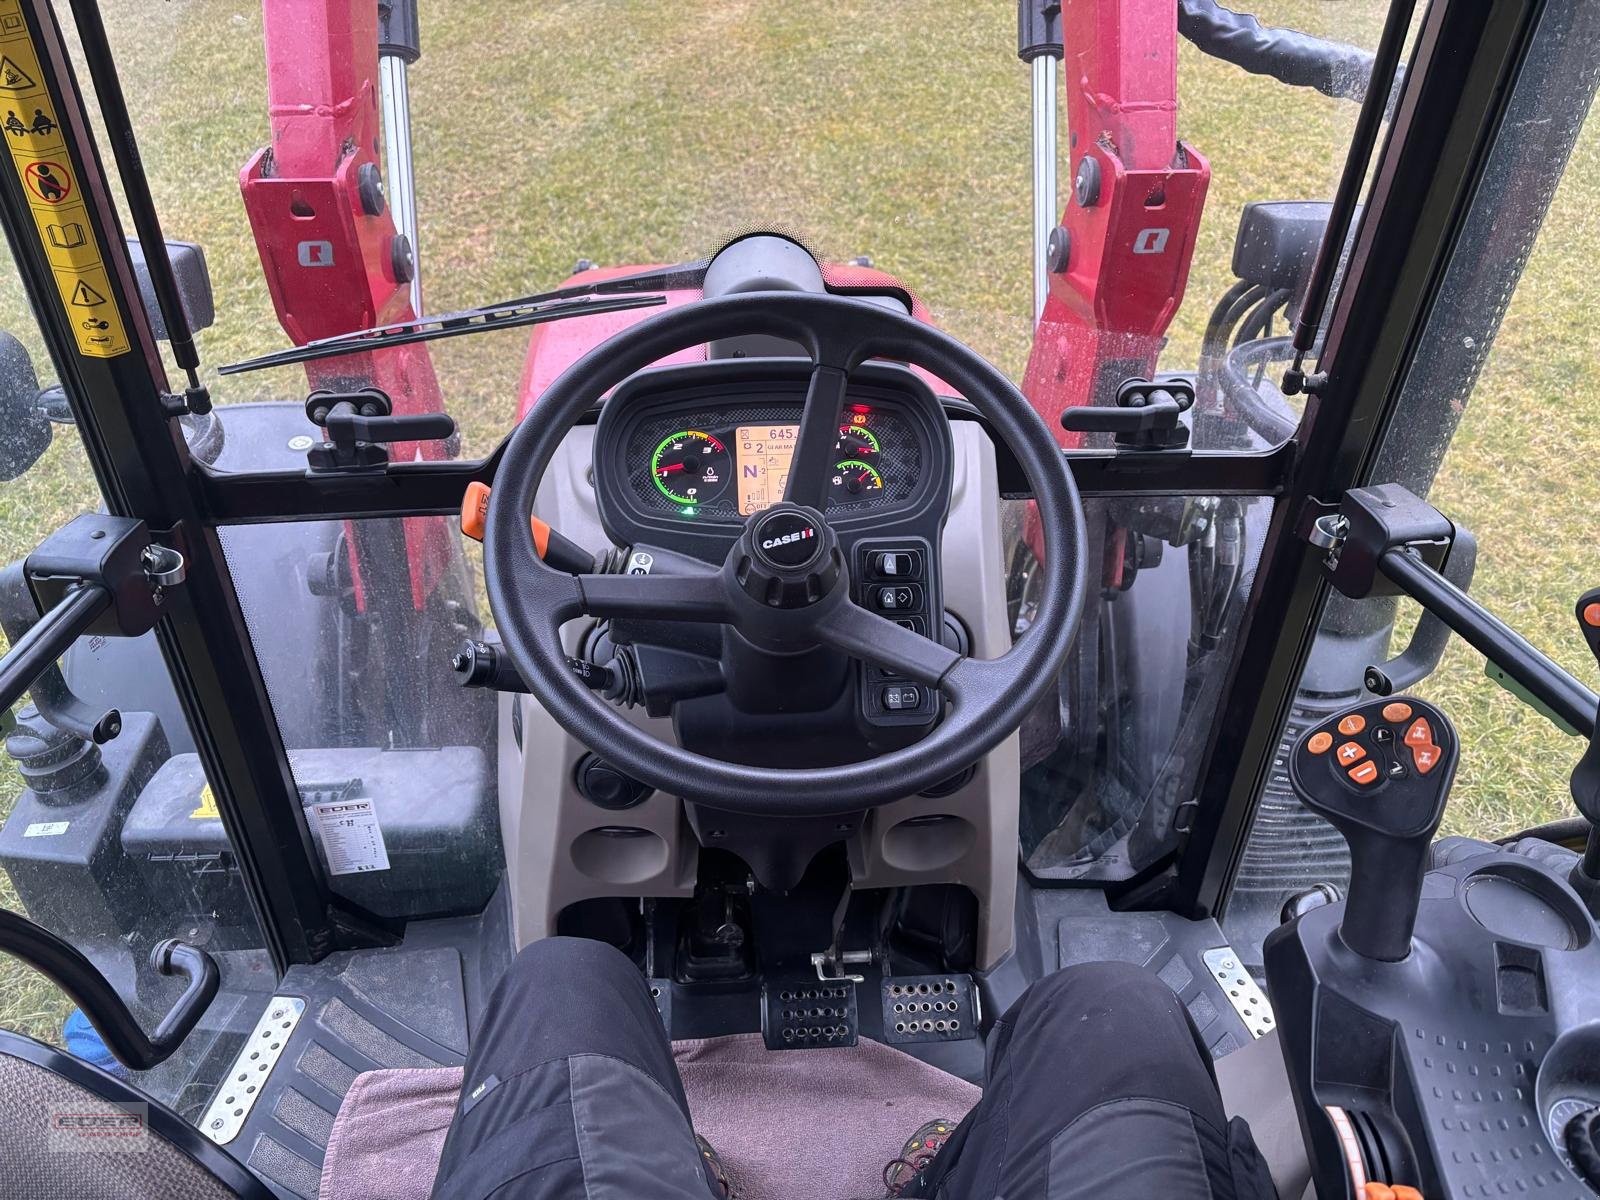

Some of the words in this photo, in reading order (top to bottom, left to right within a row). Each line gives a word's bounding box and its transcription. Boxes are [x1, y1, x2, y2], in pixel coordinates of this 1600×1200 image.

[1133, 228, 1170, 254] Q
[298, 240, 336, 267] Q
[769, 429, 800, 440] 645.
[756, 443, 764, 453] 2
[743, 465, 758, 478] N
[762, 532, 801, 549] CASE
[319, 803, 369, 814] EDER
